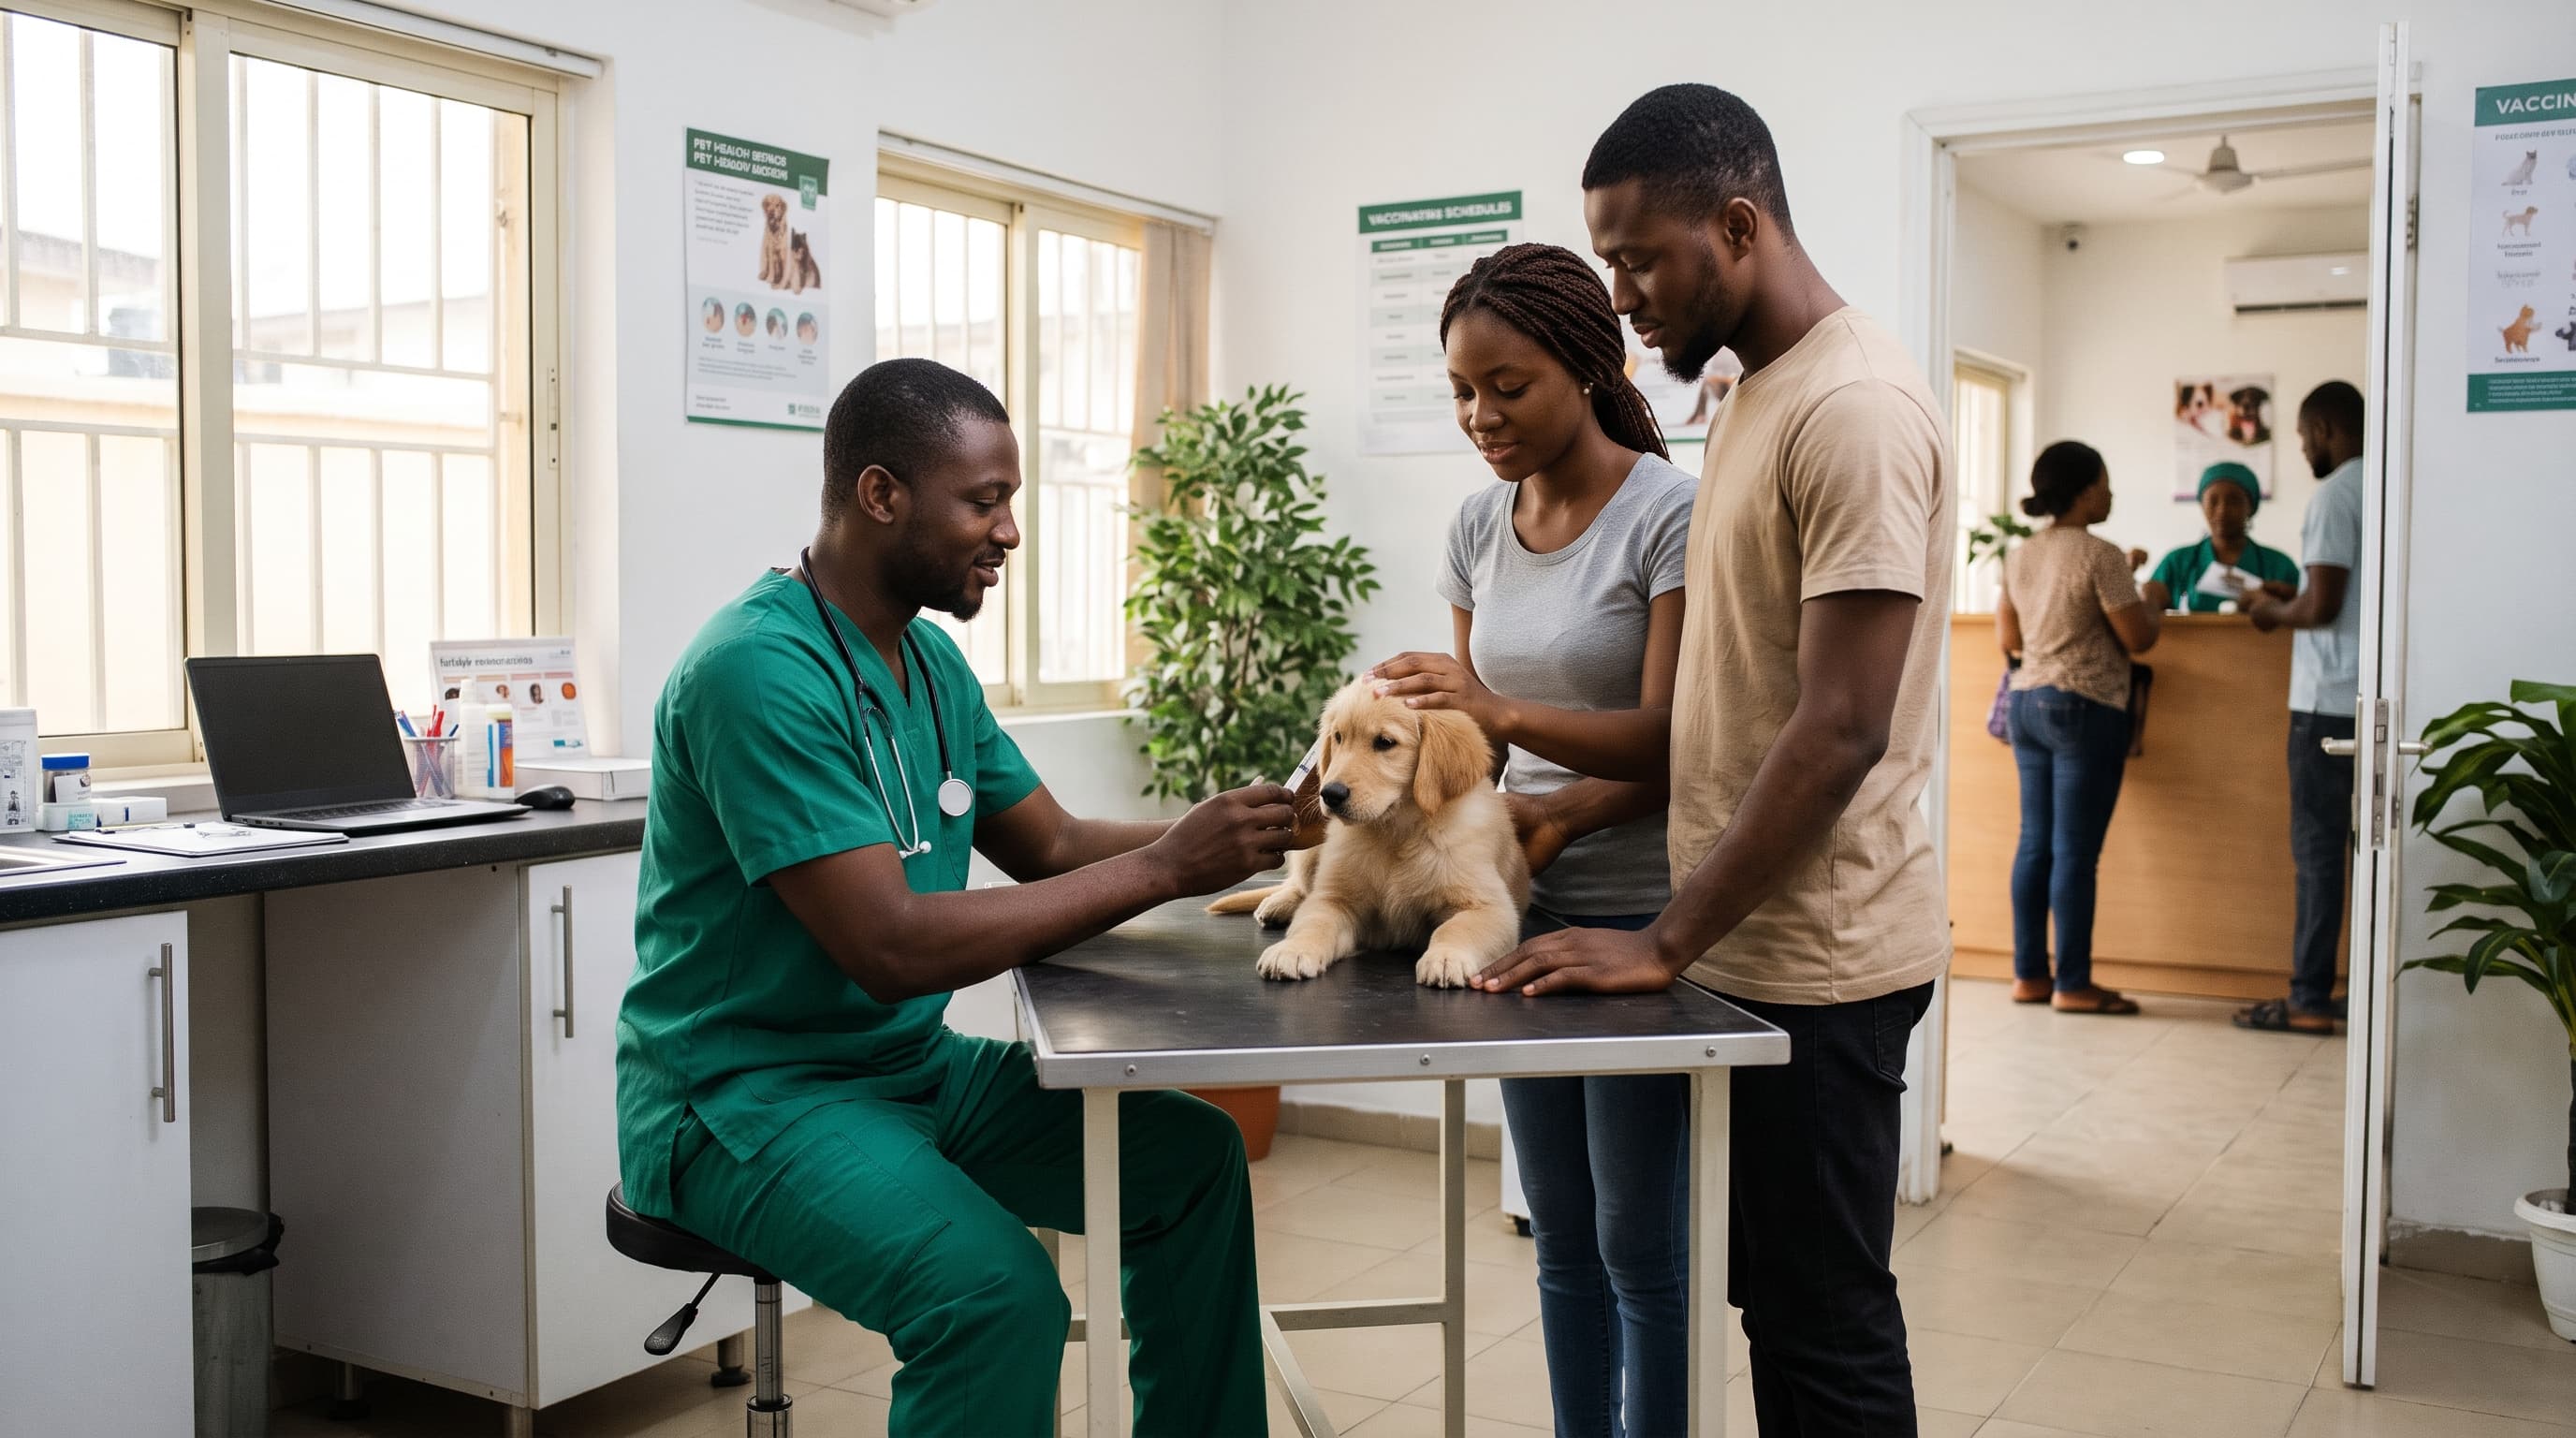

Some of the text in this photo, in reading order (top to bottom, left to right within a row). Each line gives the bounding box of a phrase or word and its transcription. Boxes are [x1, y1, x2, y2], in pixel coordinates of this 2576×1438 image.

[2496, 93, 2576, 115] VACCIN
[694, 138, 712, 150] PET
[694, 152, 712, 165] PET
